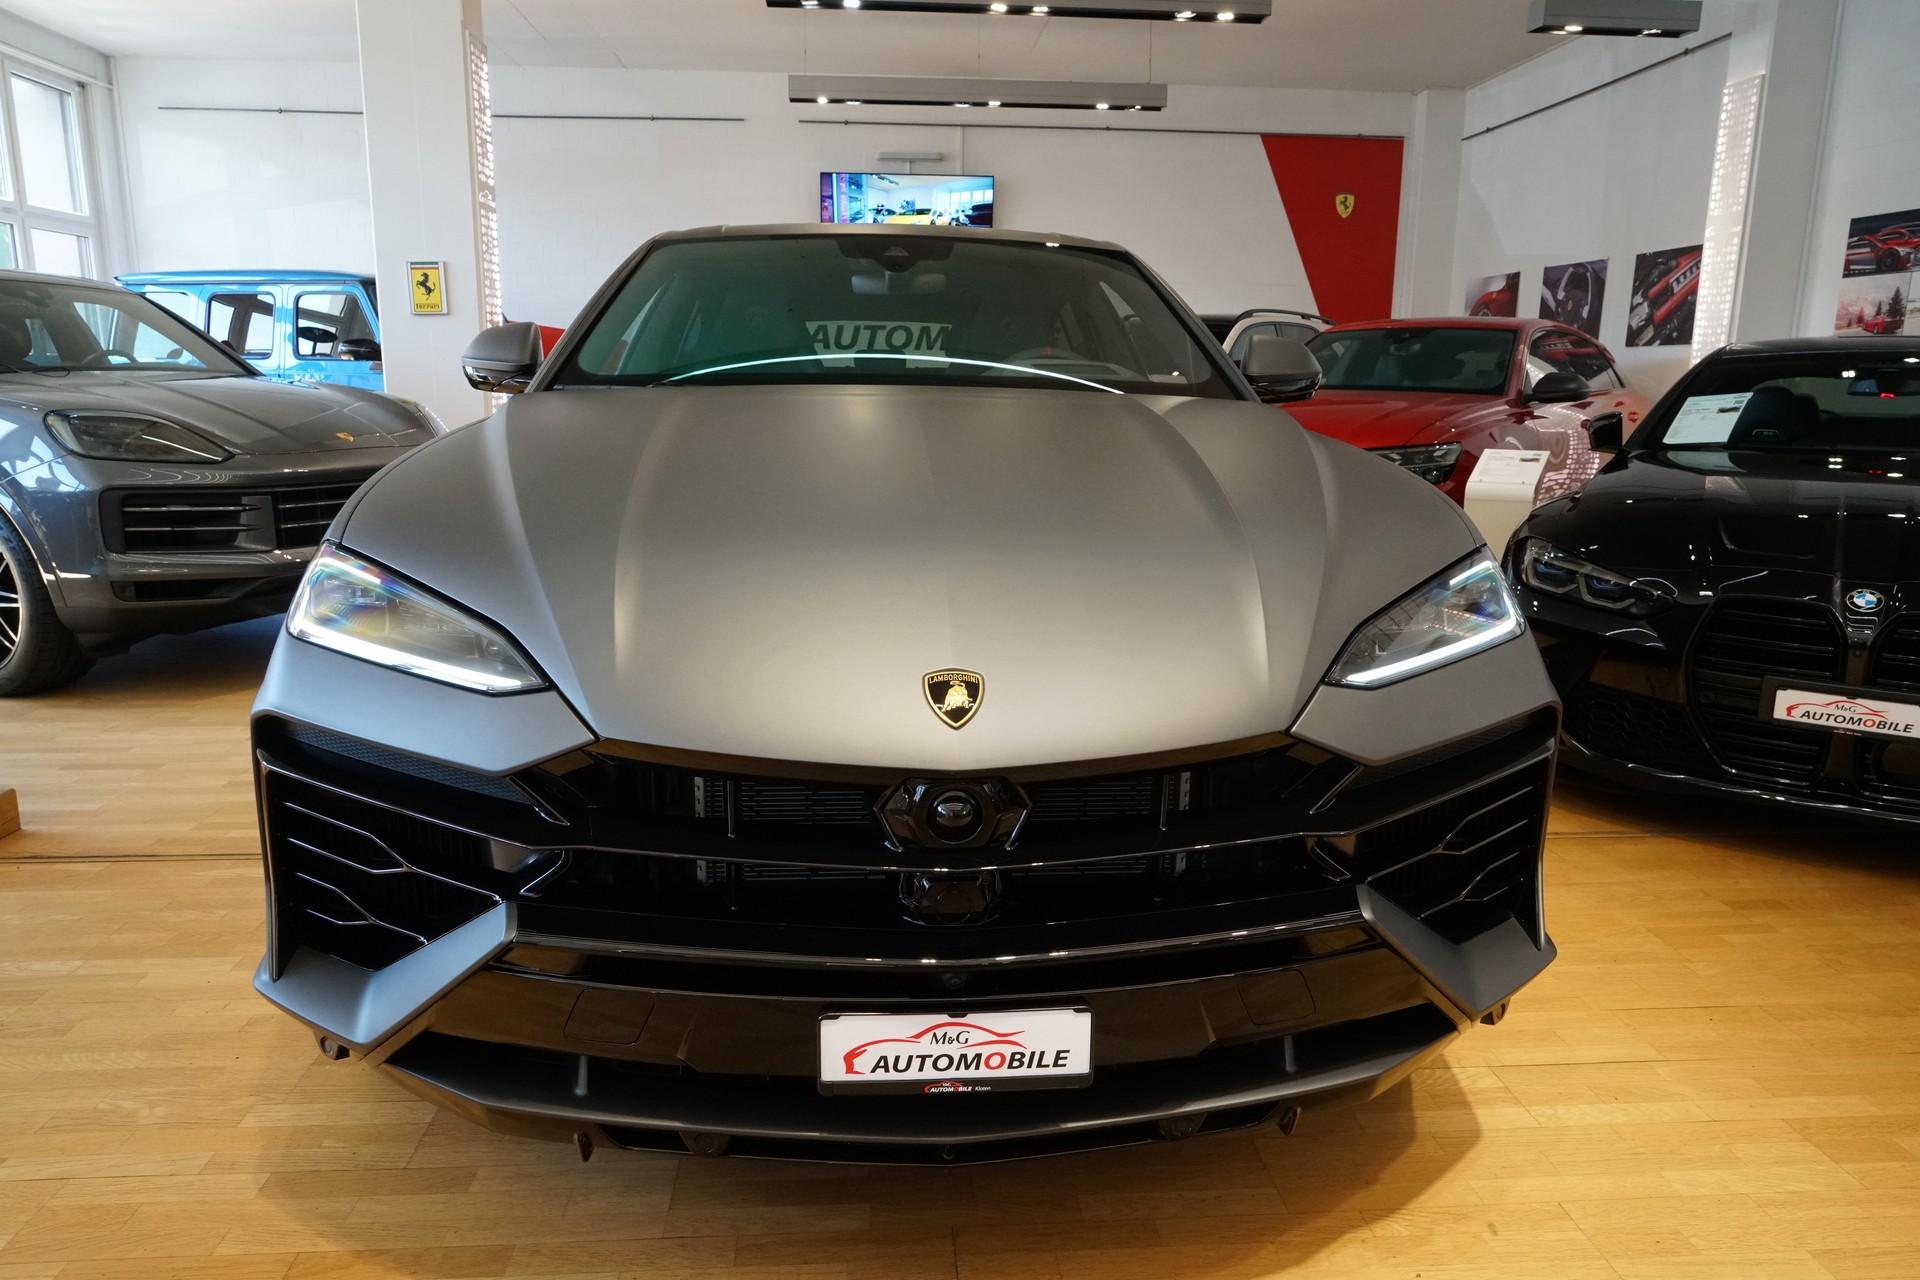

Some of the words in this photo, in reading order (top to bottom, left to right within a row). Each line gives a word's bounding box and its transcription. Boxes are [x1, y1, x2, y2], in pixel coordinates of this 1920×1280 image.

[929, 674, 978, 684] LAMBORGHINI
[1834, 704, 1857, 713] M&G
[1800, 710, 1914, 733] AUTOMOBILE
[930, 1031, 970, 1045] M&G
[870, 1050, 1070, 1073] AUTOMOBILE
